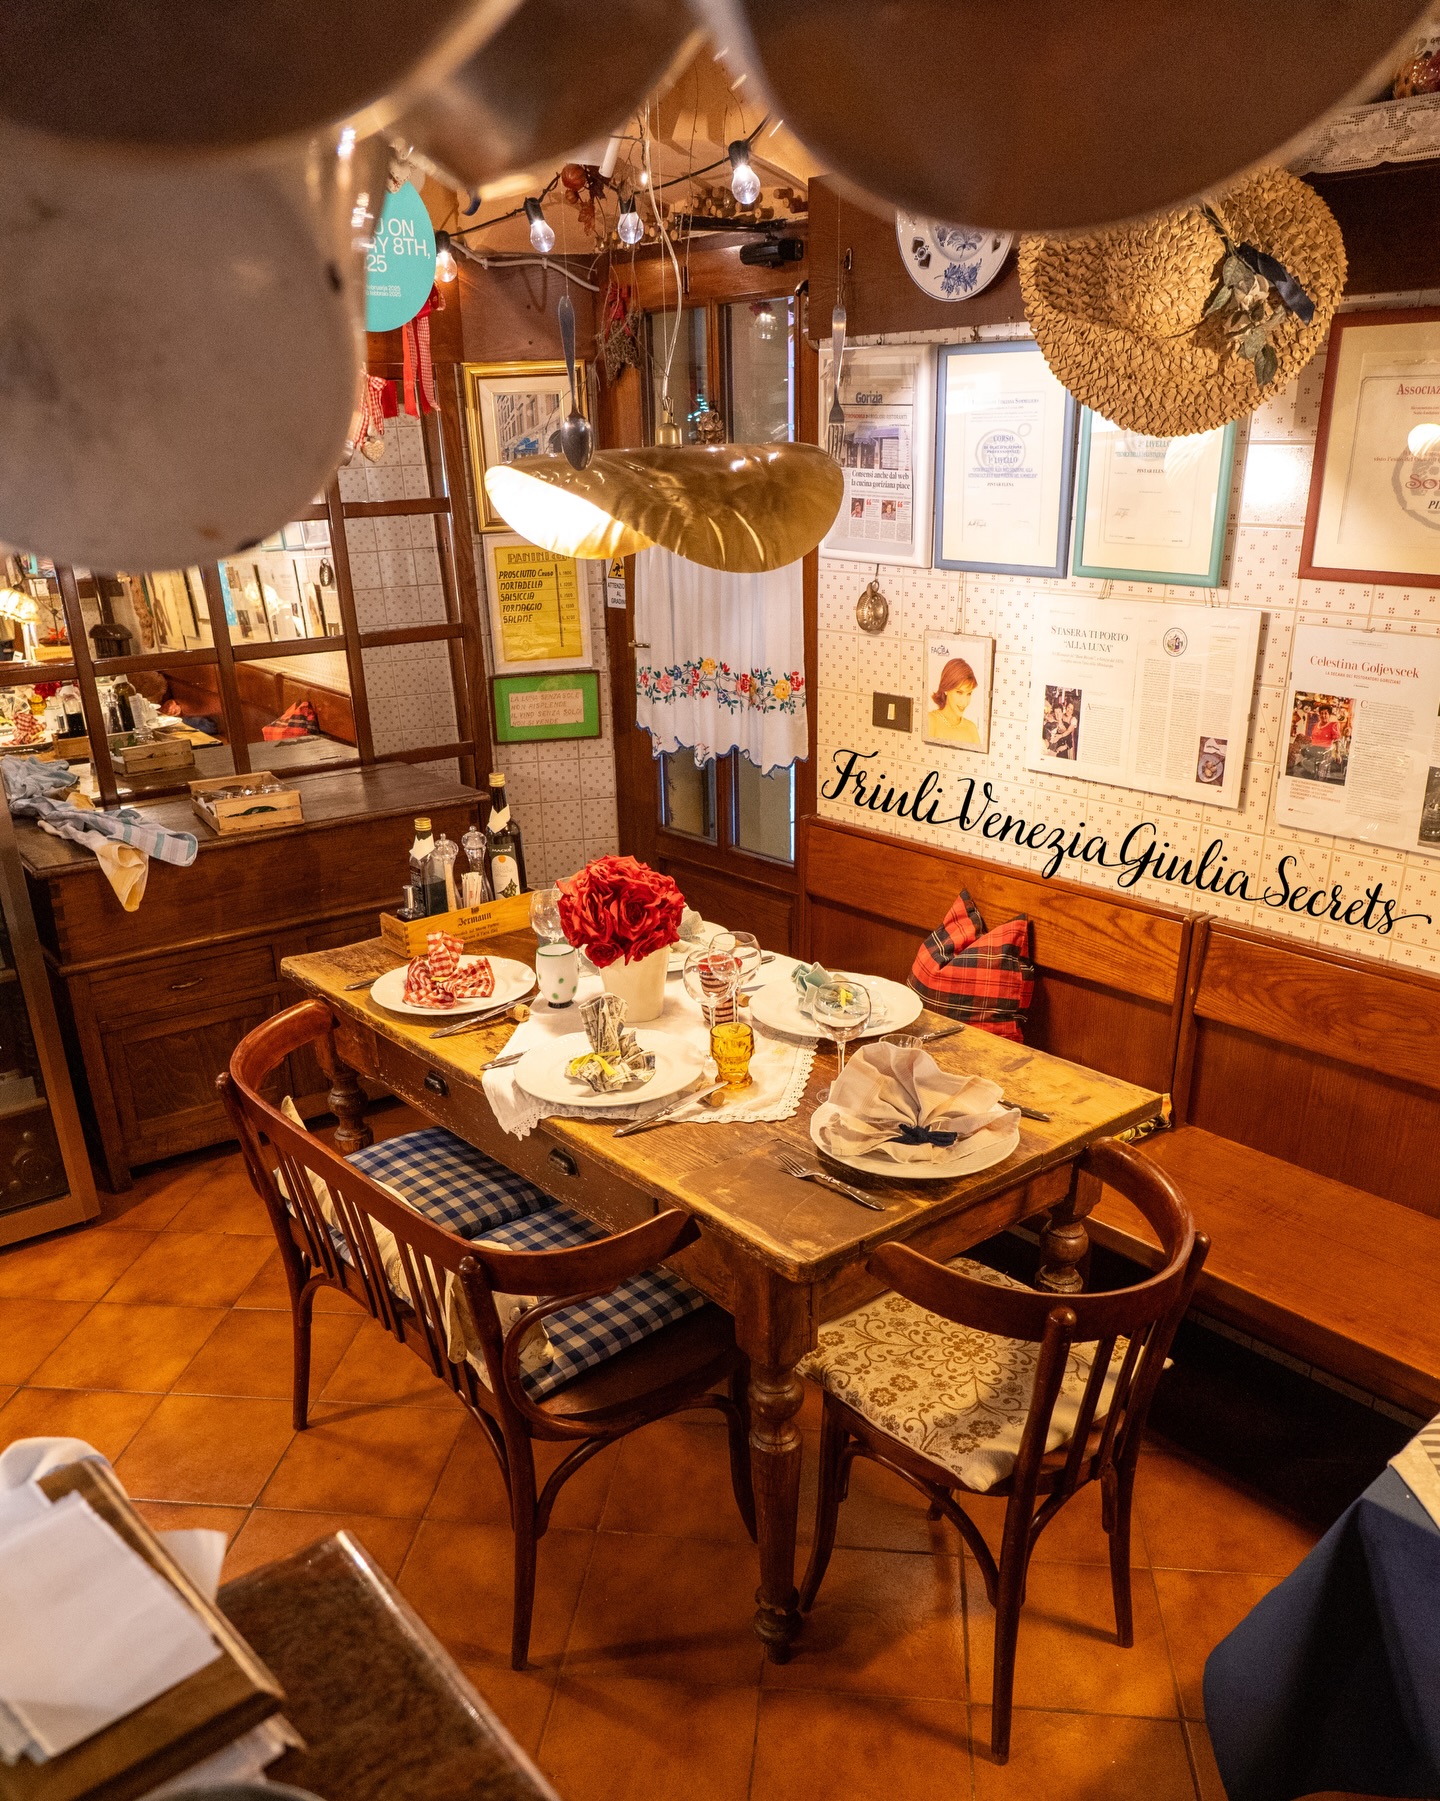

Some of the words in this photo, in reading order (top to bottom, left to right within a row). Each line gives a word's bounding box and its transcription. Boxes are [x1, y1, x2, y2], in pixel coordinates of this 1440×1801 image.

[388, 218, 414, 237] ON
[393, 237, 430, 259] 8TH,
[856, 391, 883, 404] Gorizia
[993, 434, 1014, 443] CORSO
[852, 470, 873, 478] Consensi
[889, 472, 897, 480] dal
[872, 480, 896, 489] goriziana
[896, 482, 911, 491] piace
[508, 551, 550, 564] PANINI
[498, 569, 537, 580] PROSCIUTTO
[500, 580, 543, 590] MORTADELLA
[500, 591, 535, 602] SALSICCIA
[502, 602, 543, 613] FORMAGGIO
[503, 614, 533, 624] SALAME
[1050, 625, 1087, 638] STASERA
[1088, 630, 1098, 639] TI
[1099, 631, 1129, 642] PORTO
[1310, 655, 1358, 671] Celestina
[1361, 662, 1420, 679] Goljevscek
[520, 711, 535, 719] VINO
[537, 709, 560, 718] SENZA
[457, 912, 492, 928] Jermann
